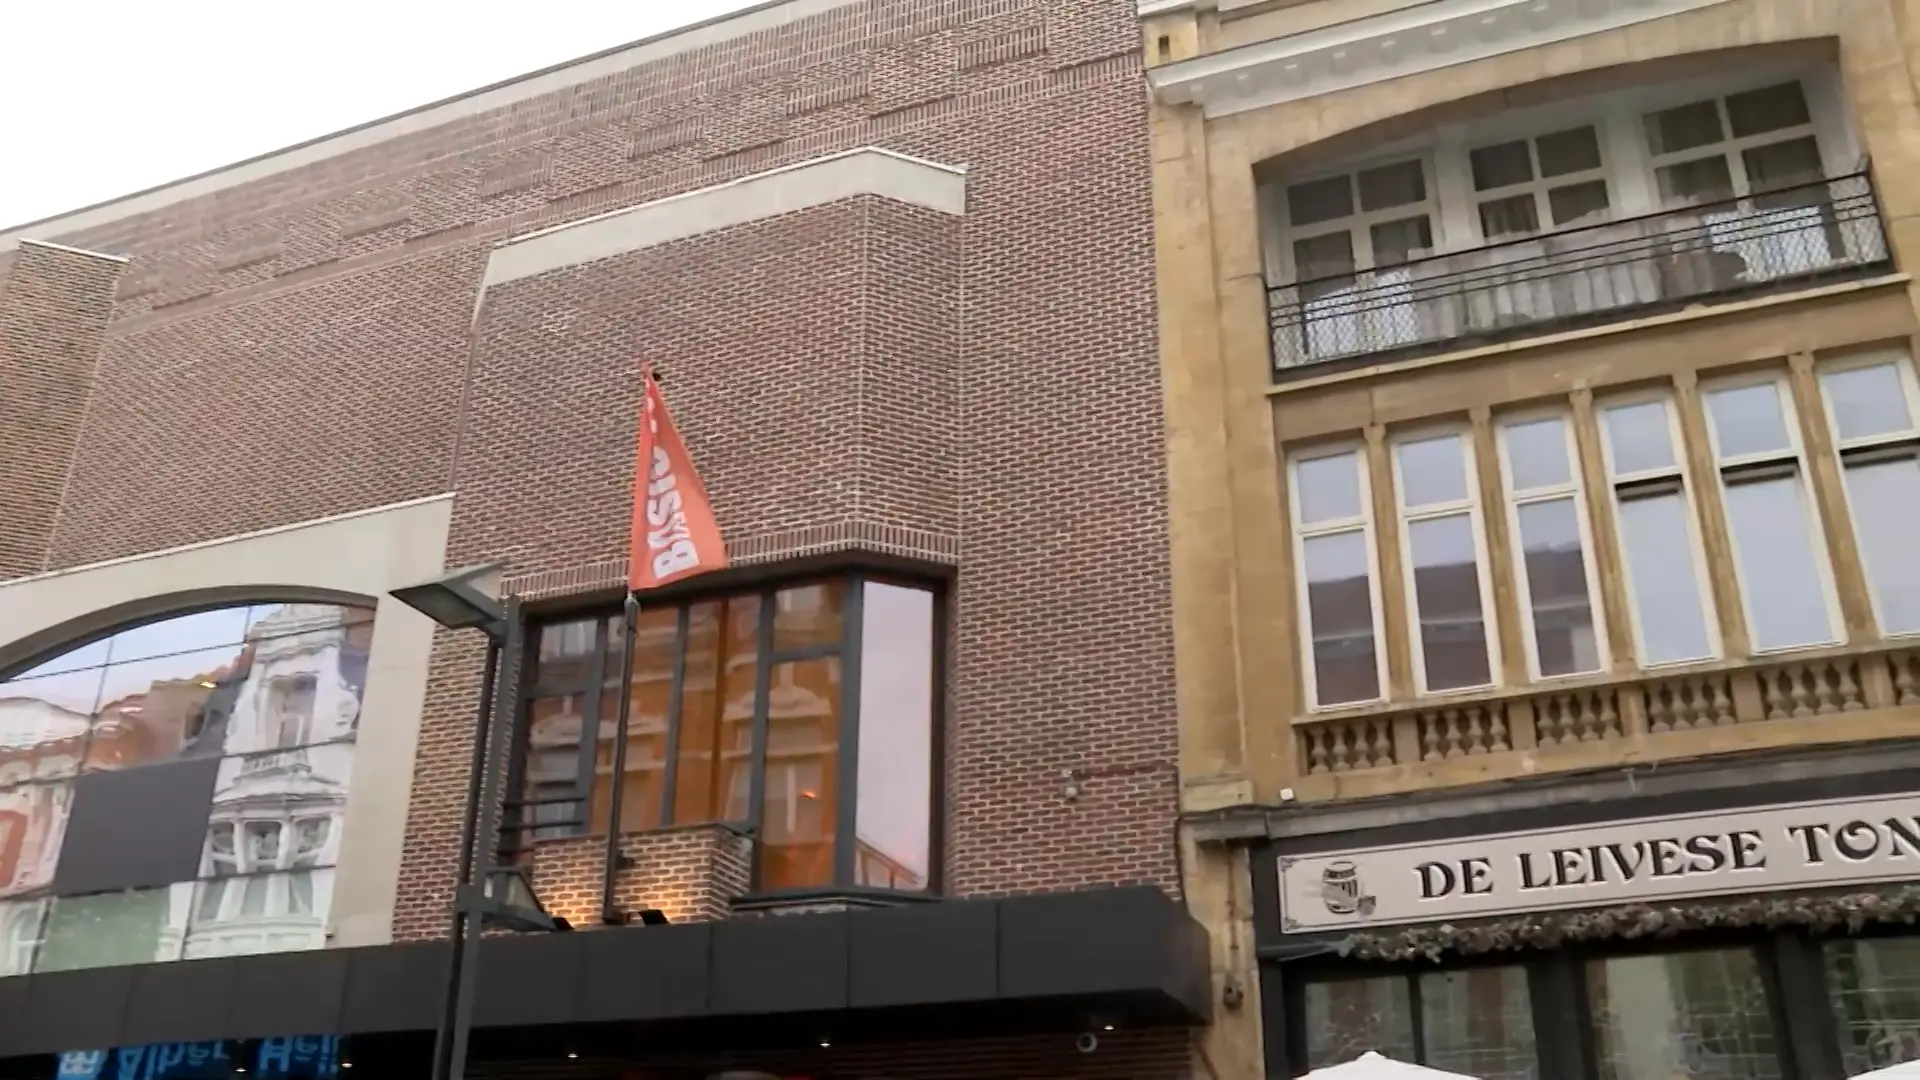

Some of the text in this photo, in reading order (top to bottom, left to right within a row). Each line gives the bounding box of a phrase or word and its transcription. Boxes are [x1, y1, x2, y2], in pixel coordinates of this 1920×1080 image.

[1415, 816, 1920, 900] DE LEIVESE TON
